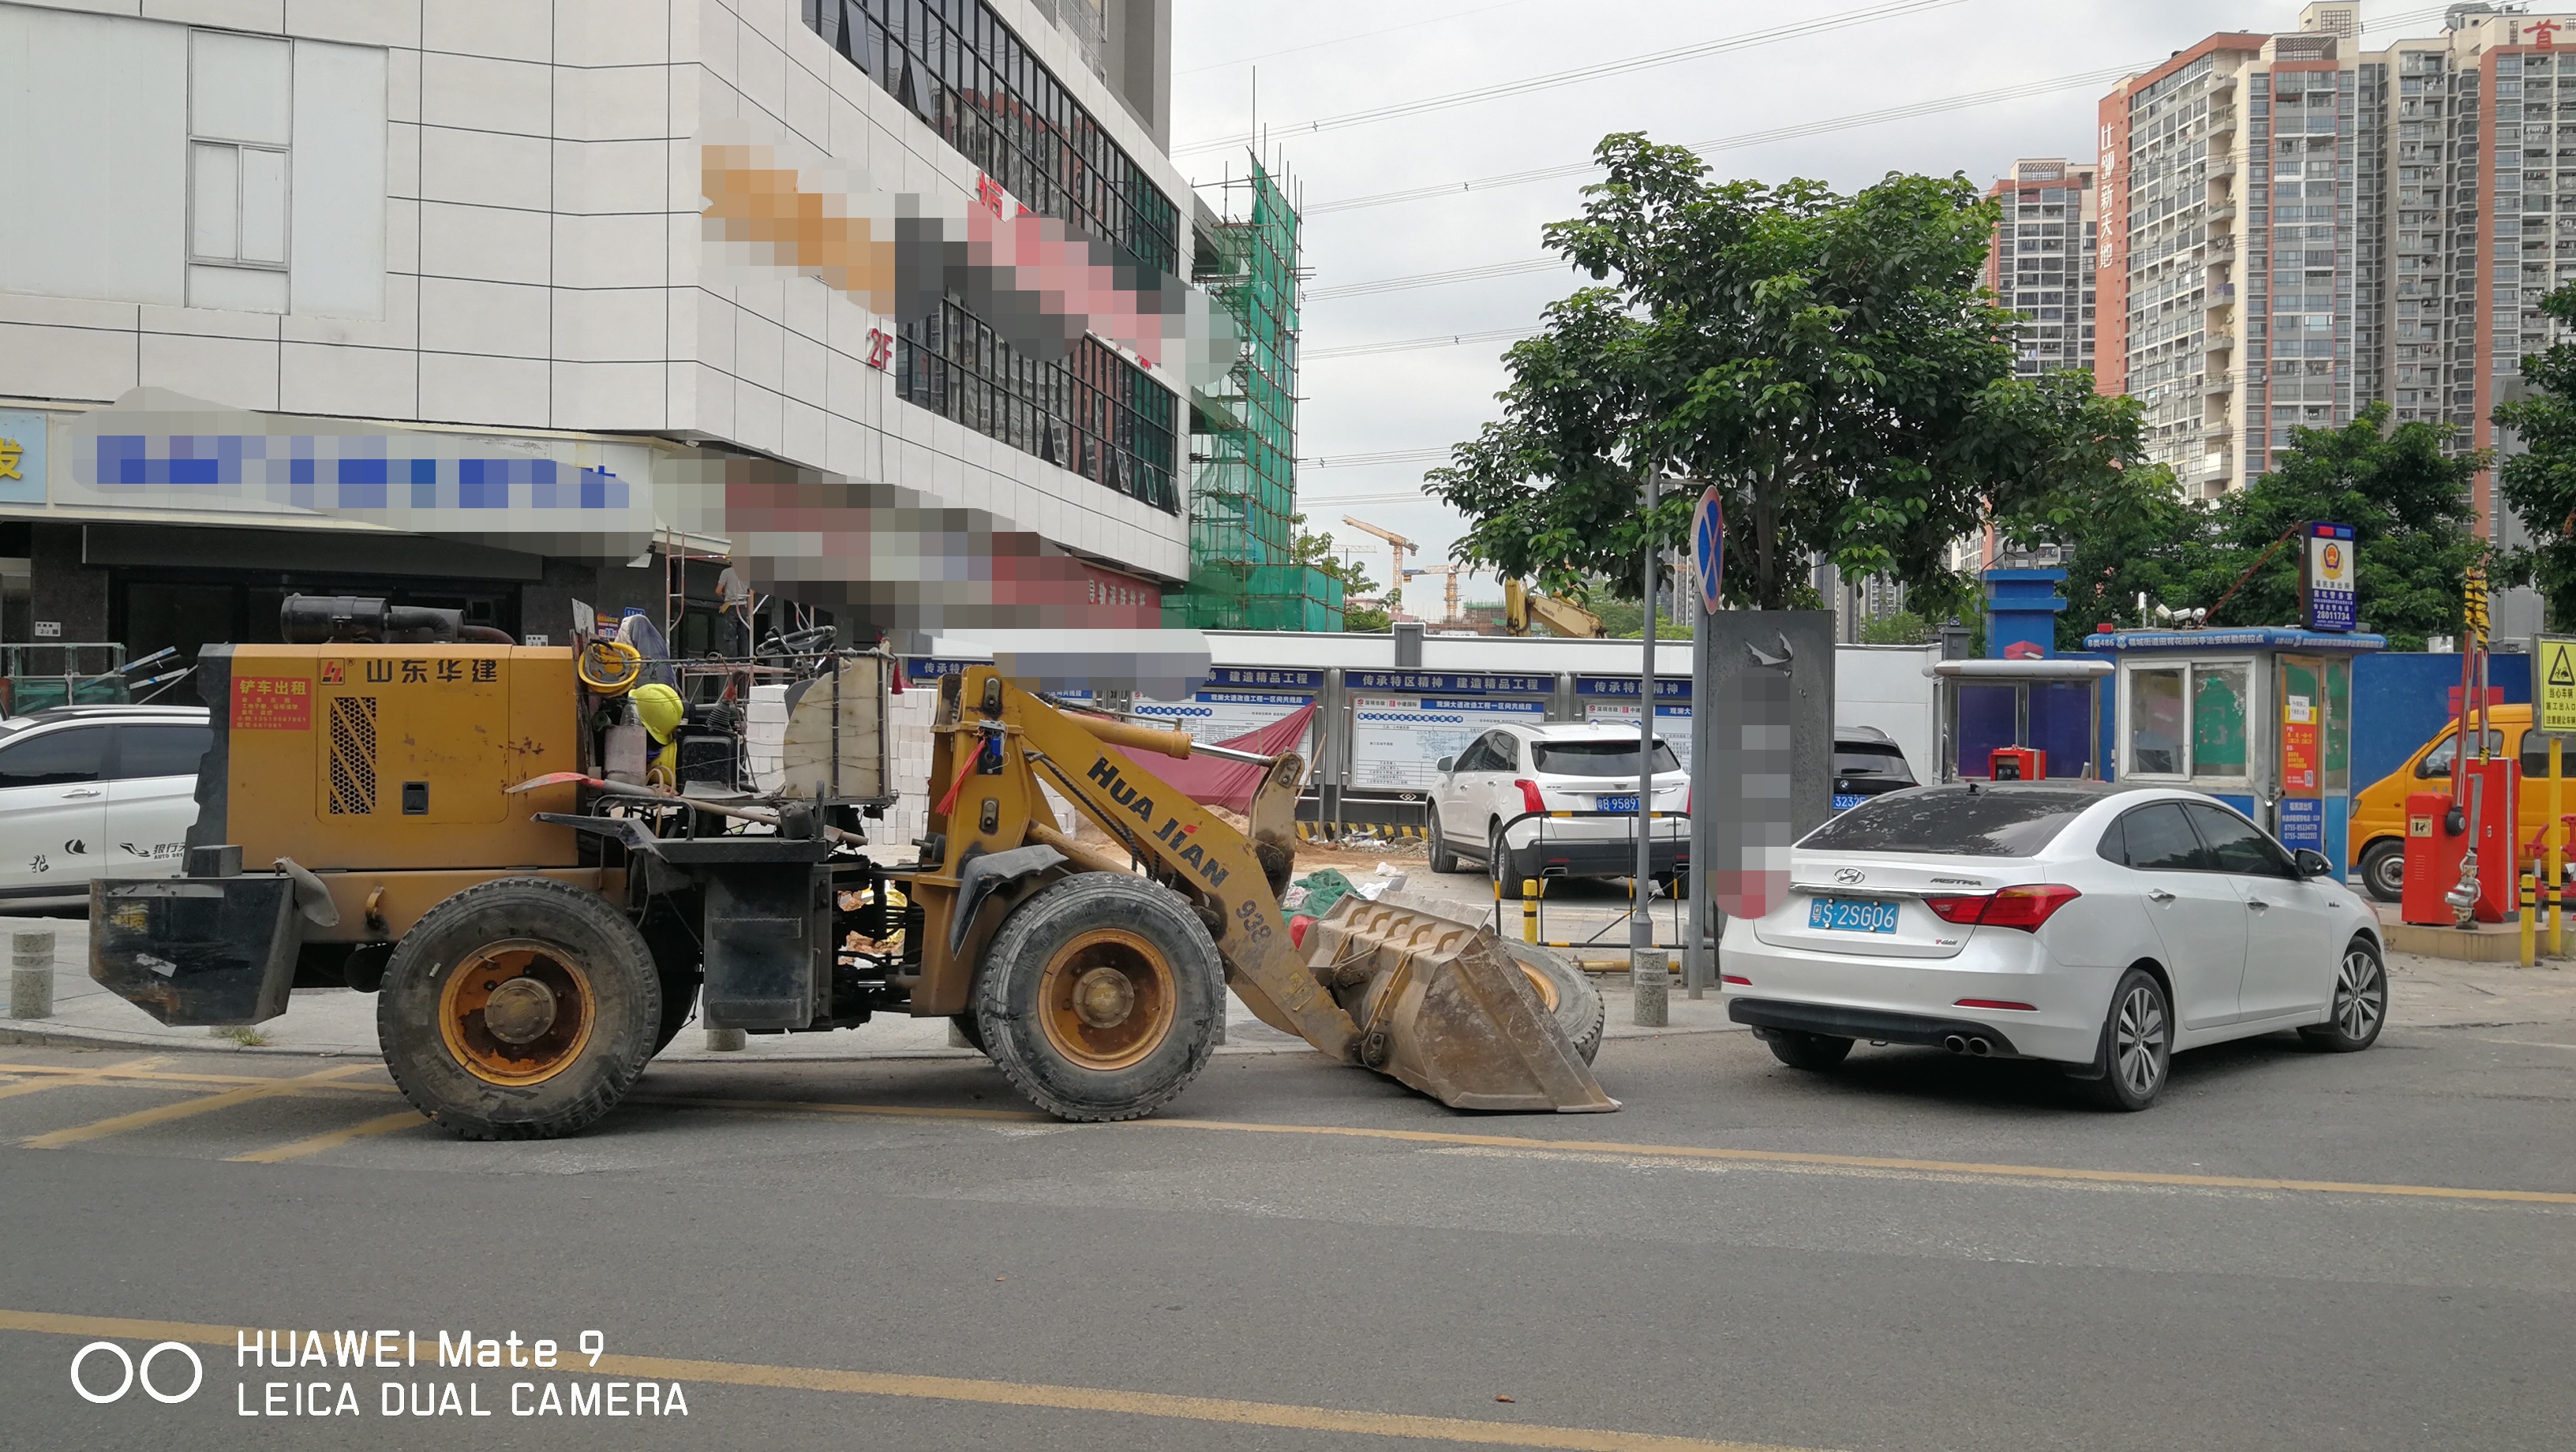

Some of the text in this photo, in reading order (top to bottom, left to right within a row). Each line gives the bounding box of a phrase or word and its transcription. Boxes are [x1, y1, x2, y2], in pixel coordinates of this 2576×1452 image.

[2523, 19, 2562, 50] 首
[869, 327, 893, 370] 2F
[2316, 611, 2350, 621] 28011734
[366, 659, 498, 684] 山东华建
[1229, 671, 1309, 685] 建造精品工程
[239, 679, 306, 695] 铲车出租
[1362, 675, 1539, 690] 传承特区精神 建造精品工程
[2548, 688, 2574, 699] 当心车辆
[1930, 877, 1983, 886] MISTRA
